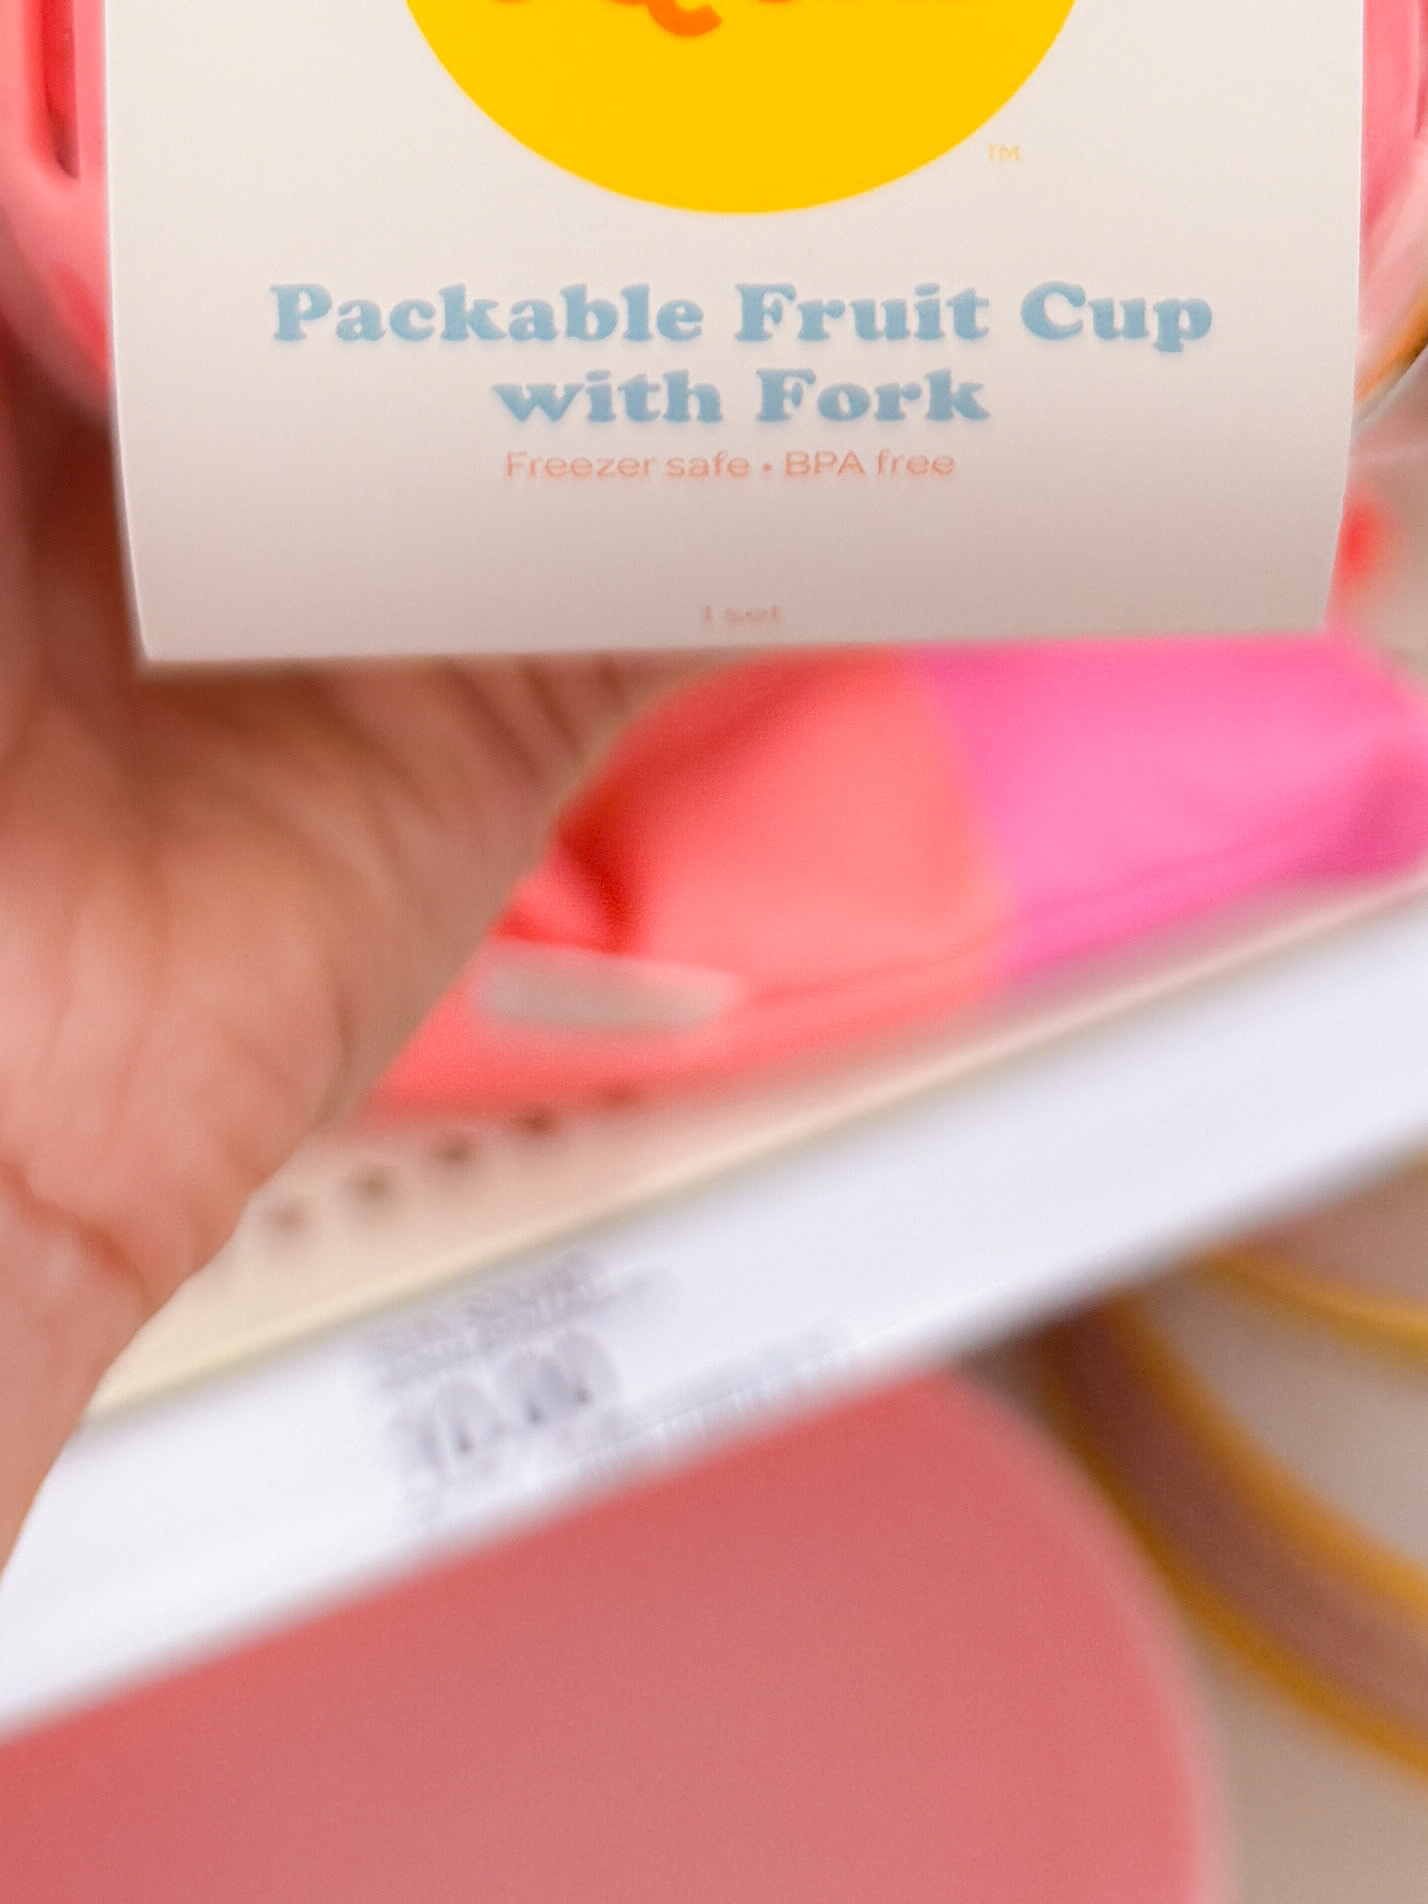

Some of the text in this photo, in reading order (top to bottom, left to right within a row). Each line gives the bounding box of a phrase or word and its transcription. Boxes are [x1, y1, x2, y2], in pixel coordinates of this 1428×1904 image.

[270, 280, 1214, 354] Packable Fruit Cup
[491, 368, 992, 425] with Fork
[505, 450, 956, 479] Freezer safe BPA free
